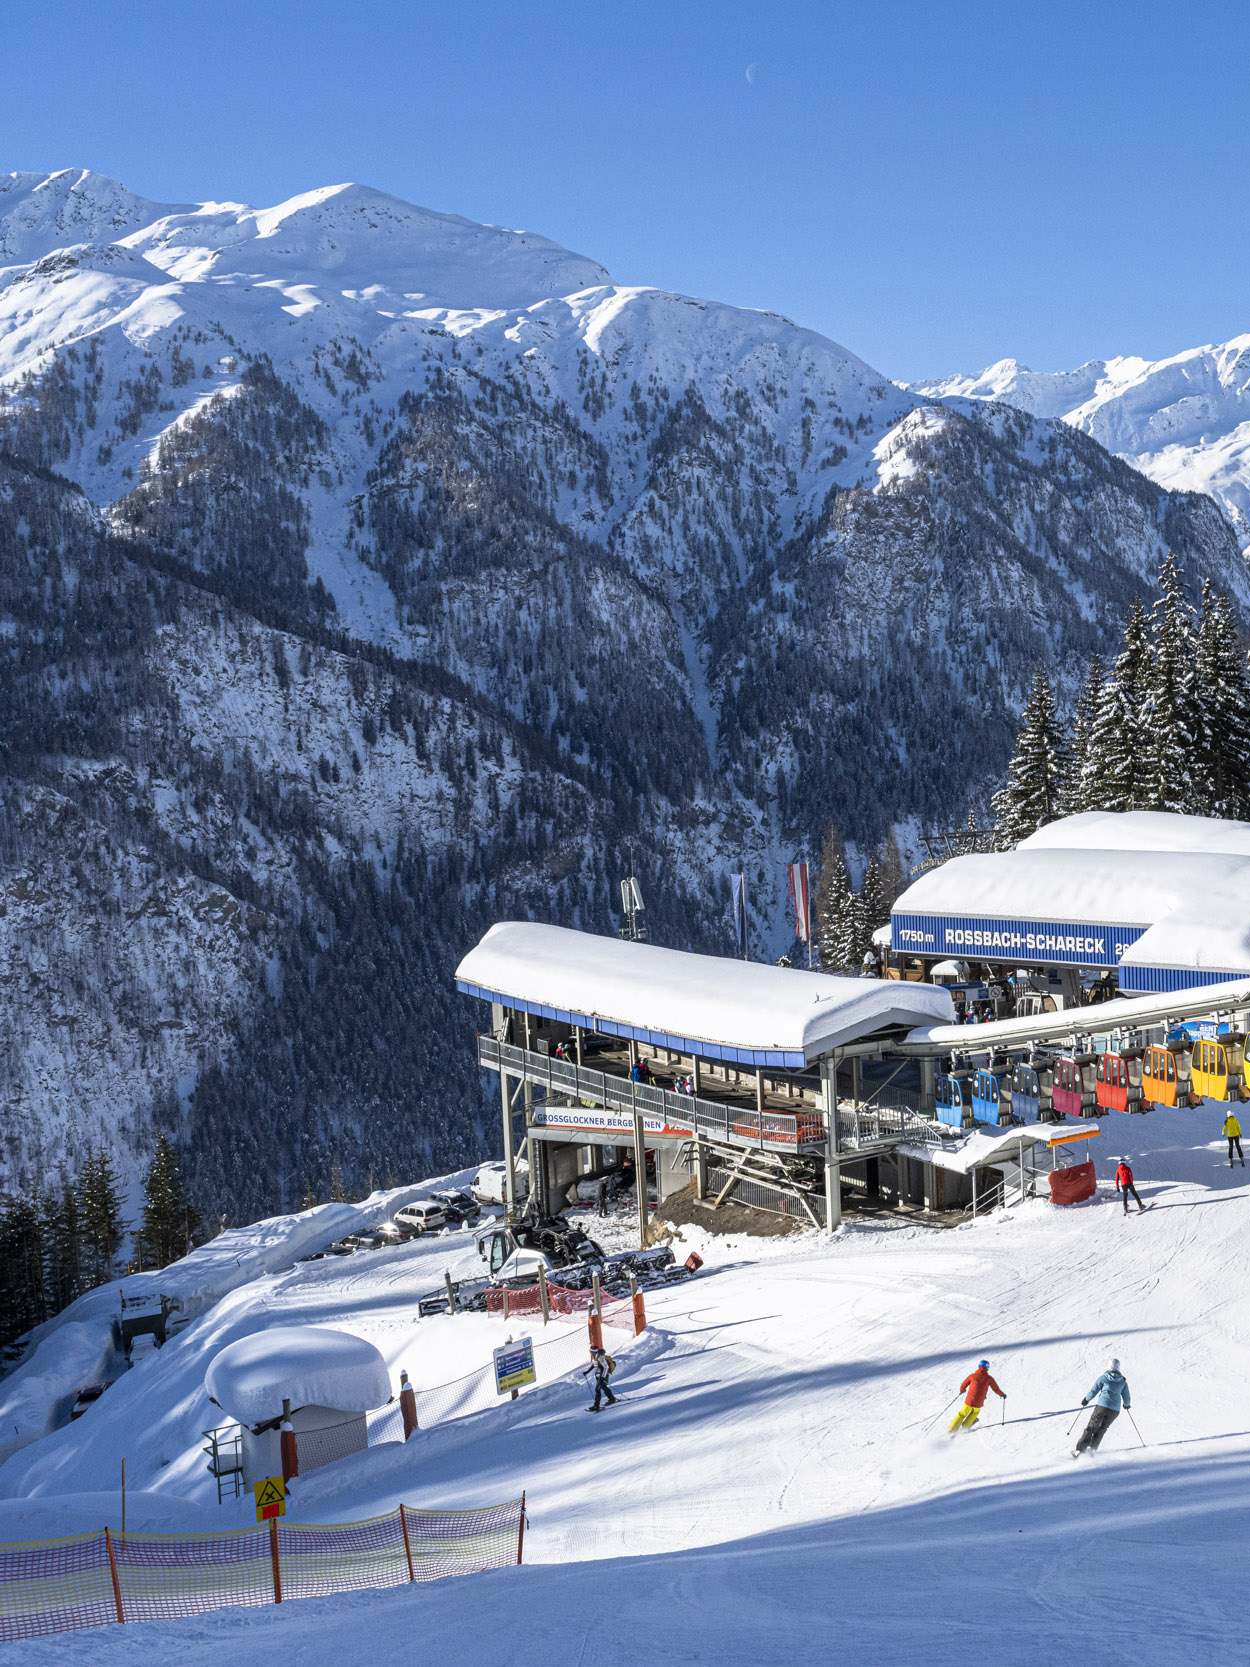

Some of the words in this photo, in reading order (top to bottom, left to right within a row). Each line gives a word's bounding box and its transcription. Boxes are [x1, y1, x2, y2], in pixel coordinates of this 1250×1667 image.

[899, 929, 924, 942] 1750
[925, 933, 934, 943] m
[945, 928, 1106, 954] ROSSBACH-SCHARECK
[1114, 942, 1130, 955] 26
[537, 1113, 605, 1126] GROSSGLOCKNER
[607, 1118, 661, 1129] BERGBNEN
